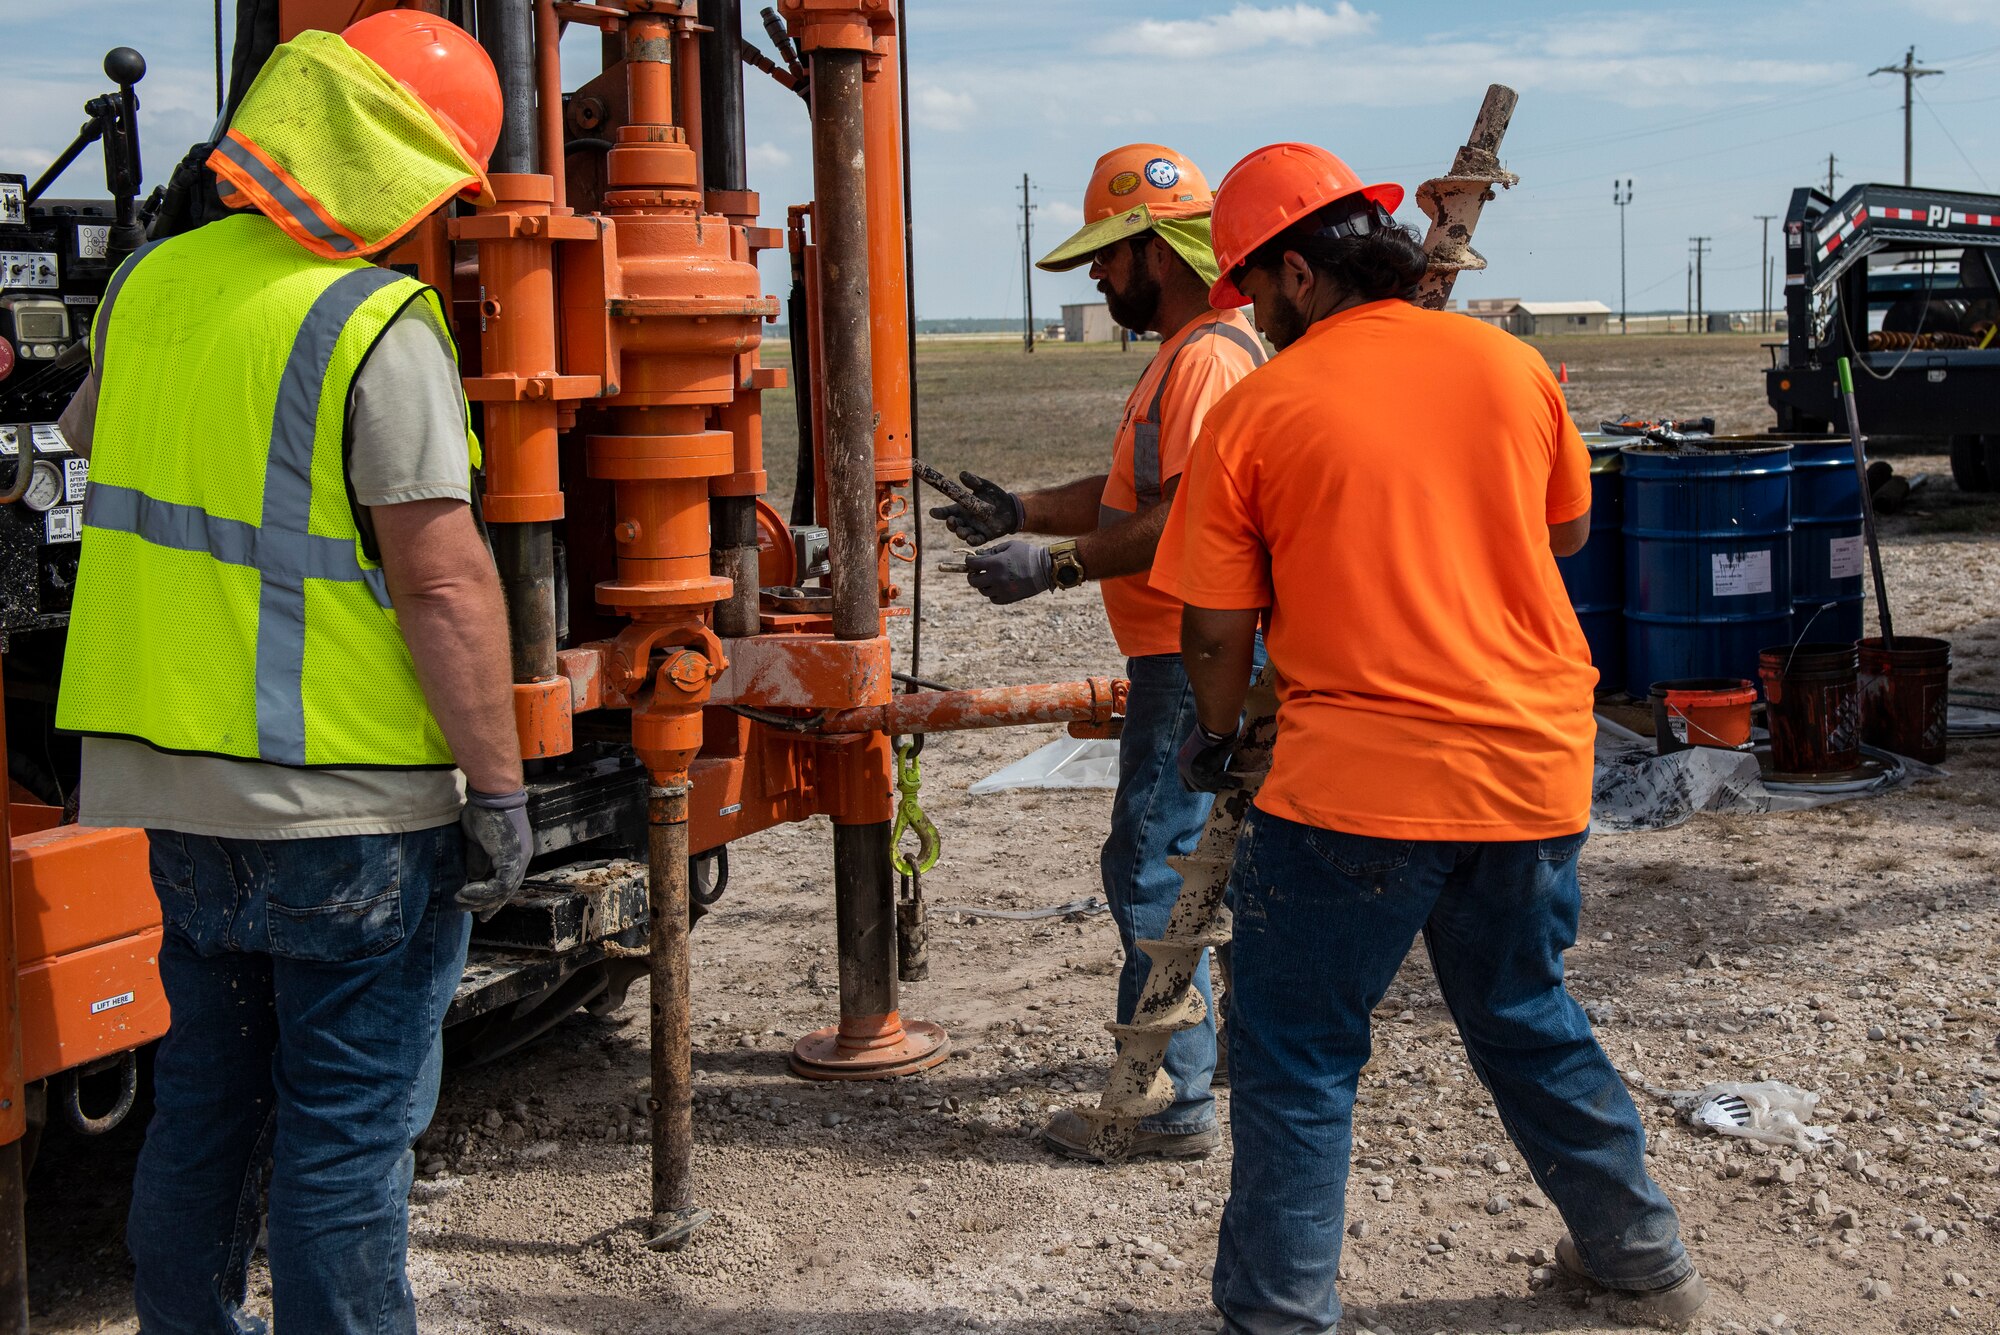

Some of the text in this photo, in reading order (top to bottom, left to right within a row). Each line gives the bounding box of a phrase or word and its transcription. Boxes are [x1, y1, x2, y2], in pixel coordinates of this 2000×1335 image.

[1927, 204, 1951, 228] PJ
[51, 532, 71, 540] WINCH
[96, 994, 129, 1010] LIFT HERE
